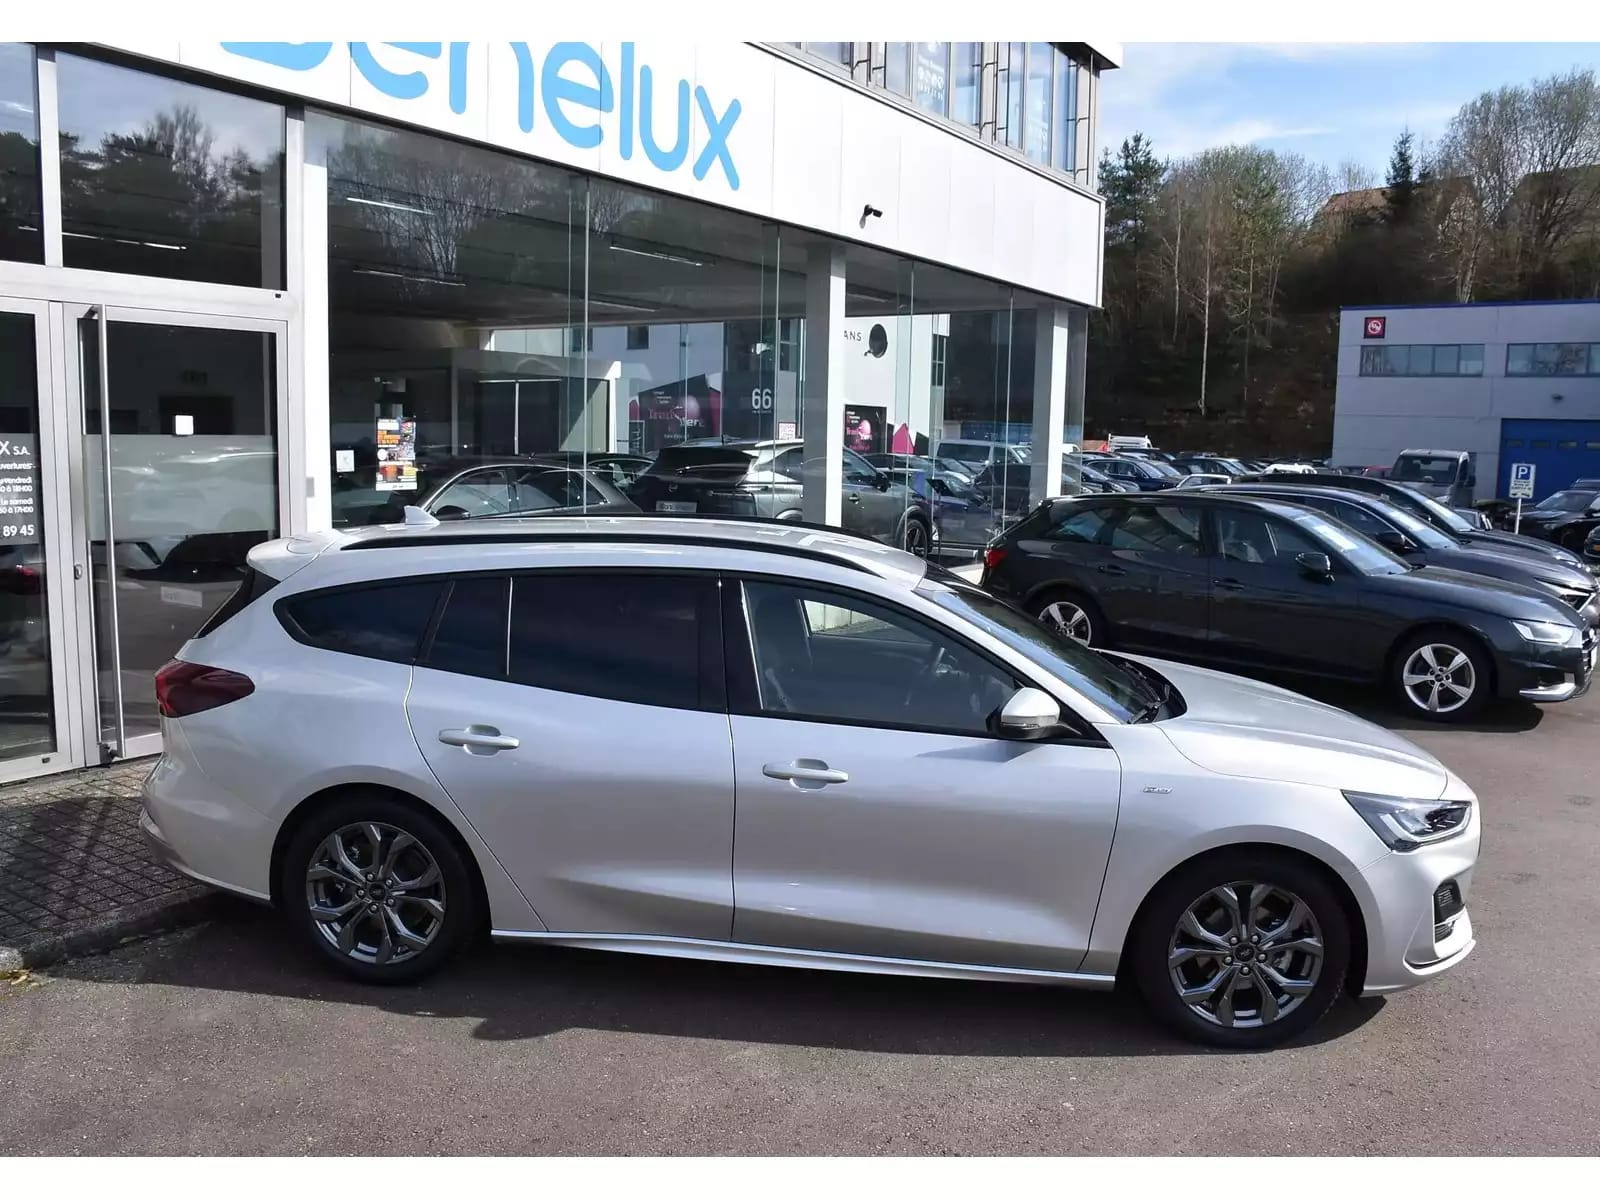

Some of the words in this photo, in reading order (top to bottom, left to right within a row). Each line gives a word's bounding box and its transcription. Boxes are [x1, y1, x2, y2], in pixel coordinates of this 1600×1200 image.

[752, 388, 772, 410] 66
[1518, 466, 1528, 479] P
[3, 525, 18, 537] 89
[20, 524, 34, 536] 45
